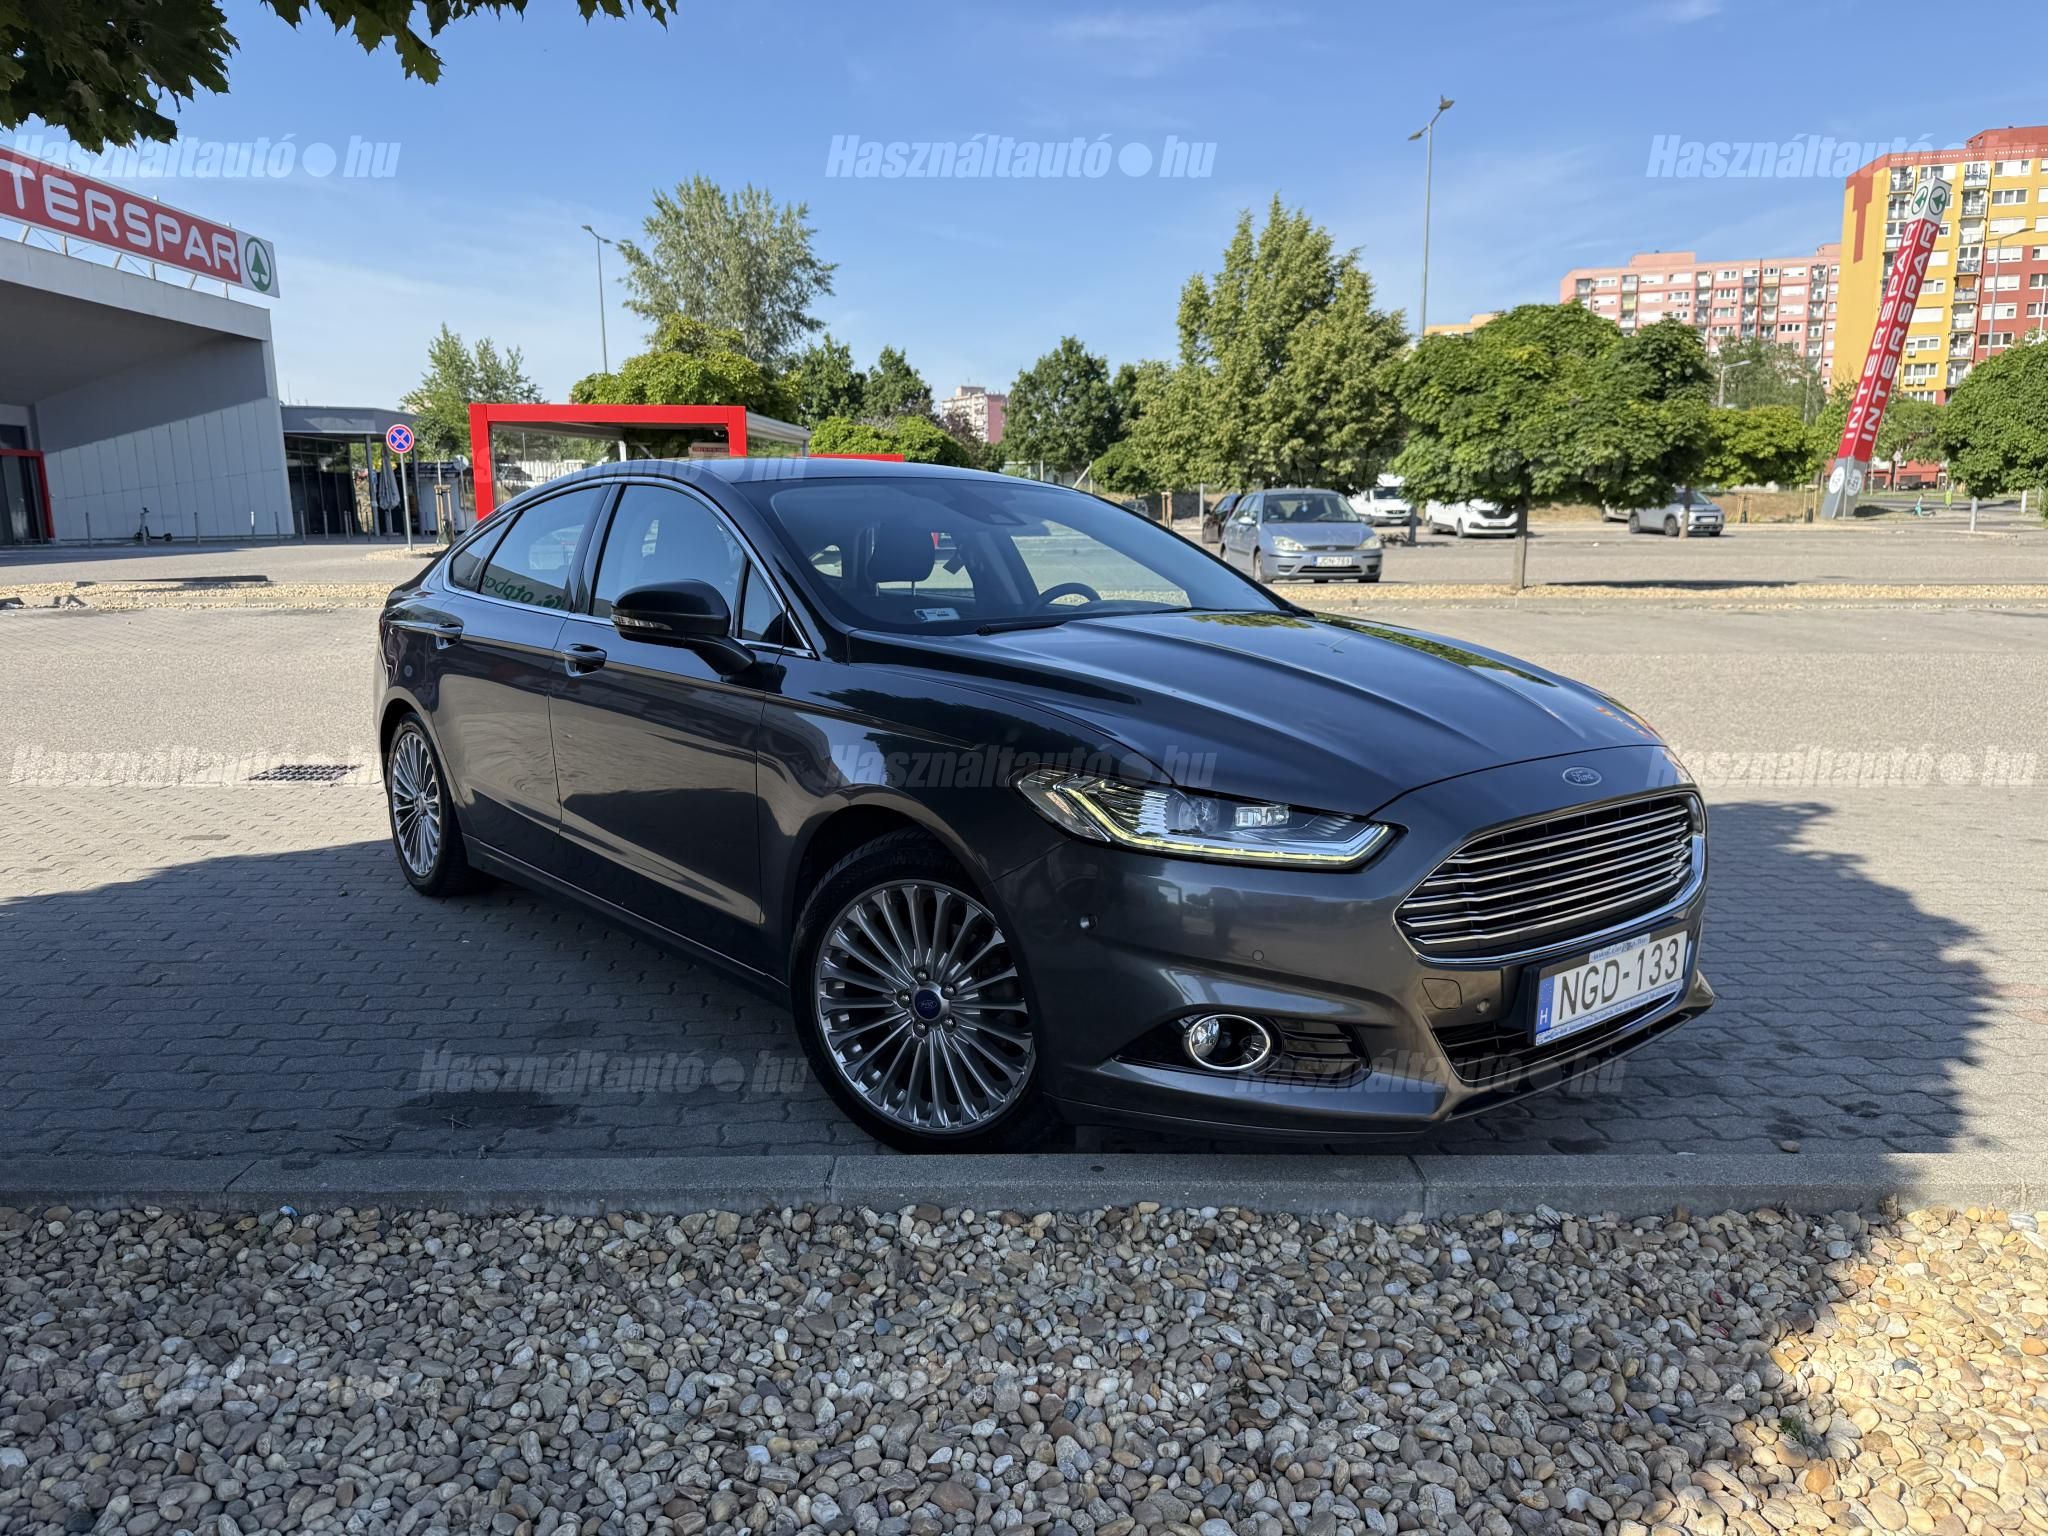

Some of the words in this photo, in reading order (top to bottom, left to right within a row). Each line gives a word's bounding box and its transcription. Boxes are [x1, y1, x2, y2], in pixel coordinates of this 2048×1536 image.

[1846, 221, 1917, 439] INTERSPAR
[1861, 222, 1939, 442] INTERSPAR
[1539, 1008, 1549, 1025] H
[1559, 938, 1679, 1021] NGD-133
